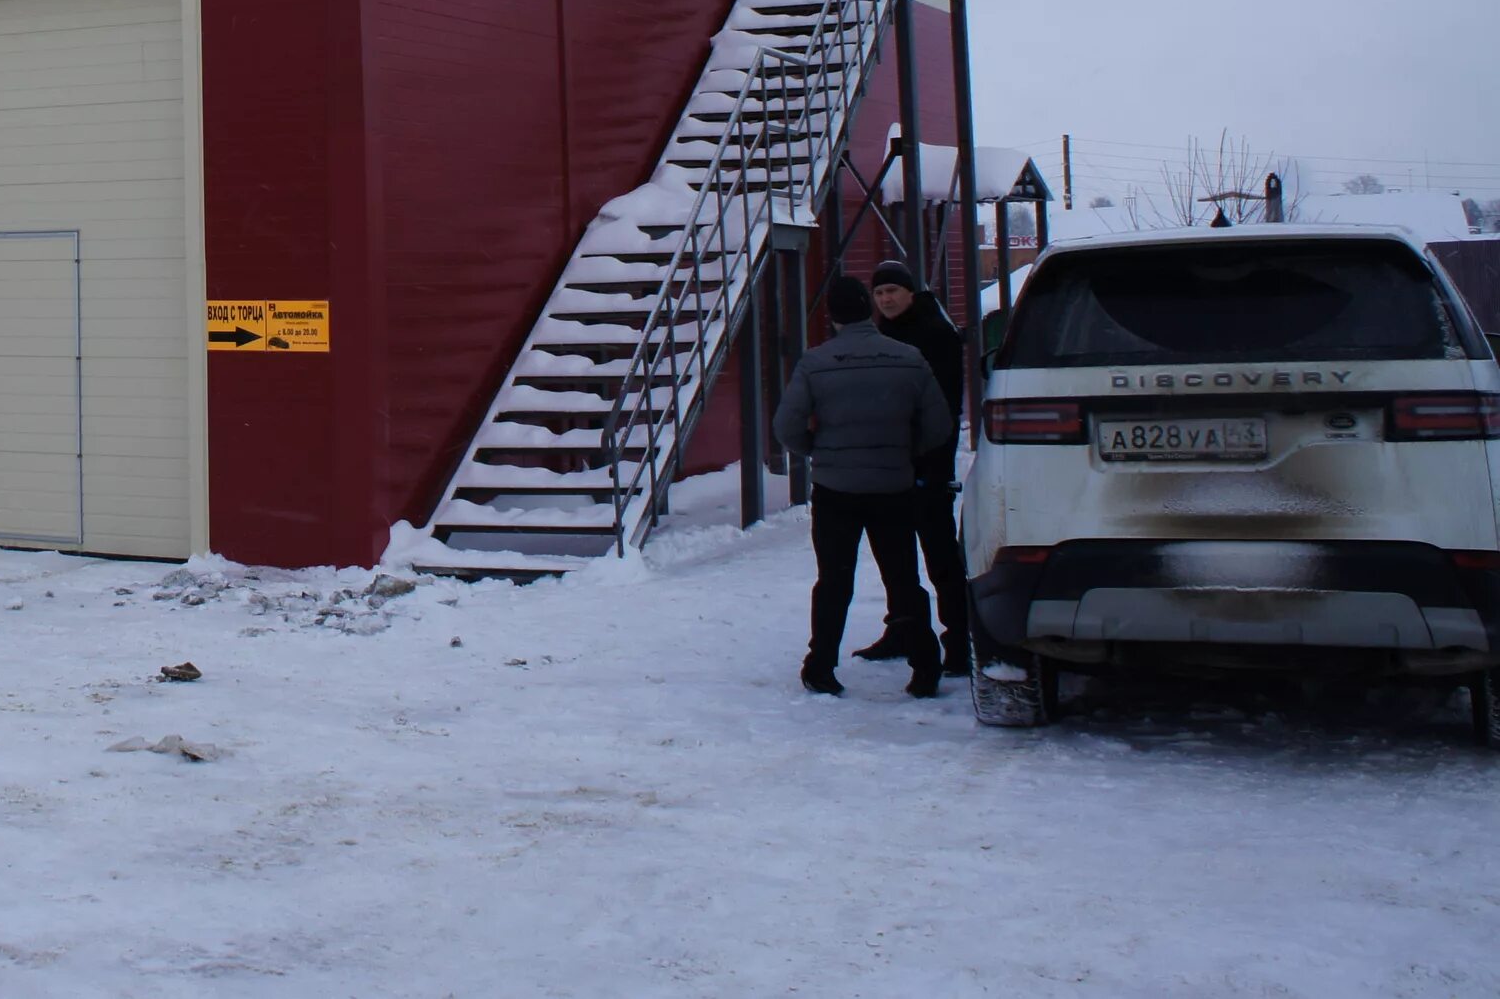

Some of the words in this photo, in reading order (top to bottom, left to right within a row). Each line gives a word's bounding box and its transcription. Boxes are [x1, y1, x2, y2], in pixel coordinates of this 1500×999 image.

[207, 305, 229, 322] ВХОД
[230, 305, 236, 321] С
[238, 305, 264, 322] ТОРЦА
[272, 310, 324, 320] АВТОМОЙКА
[1111, 370, 1353, 389] DISCOVERY
